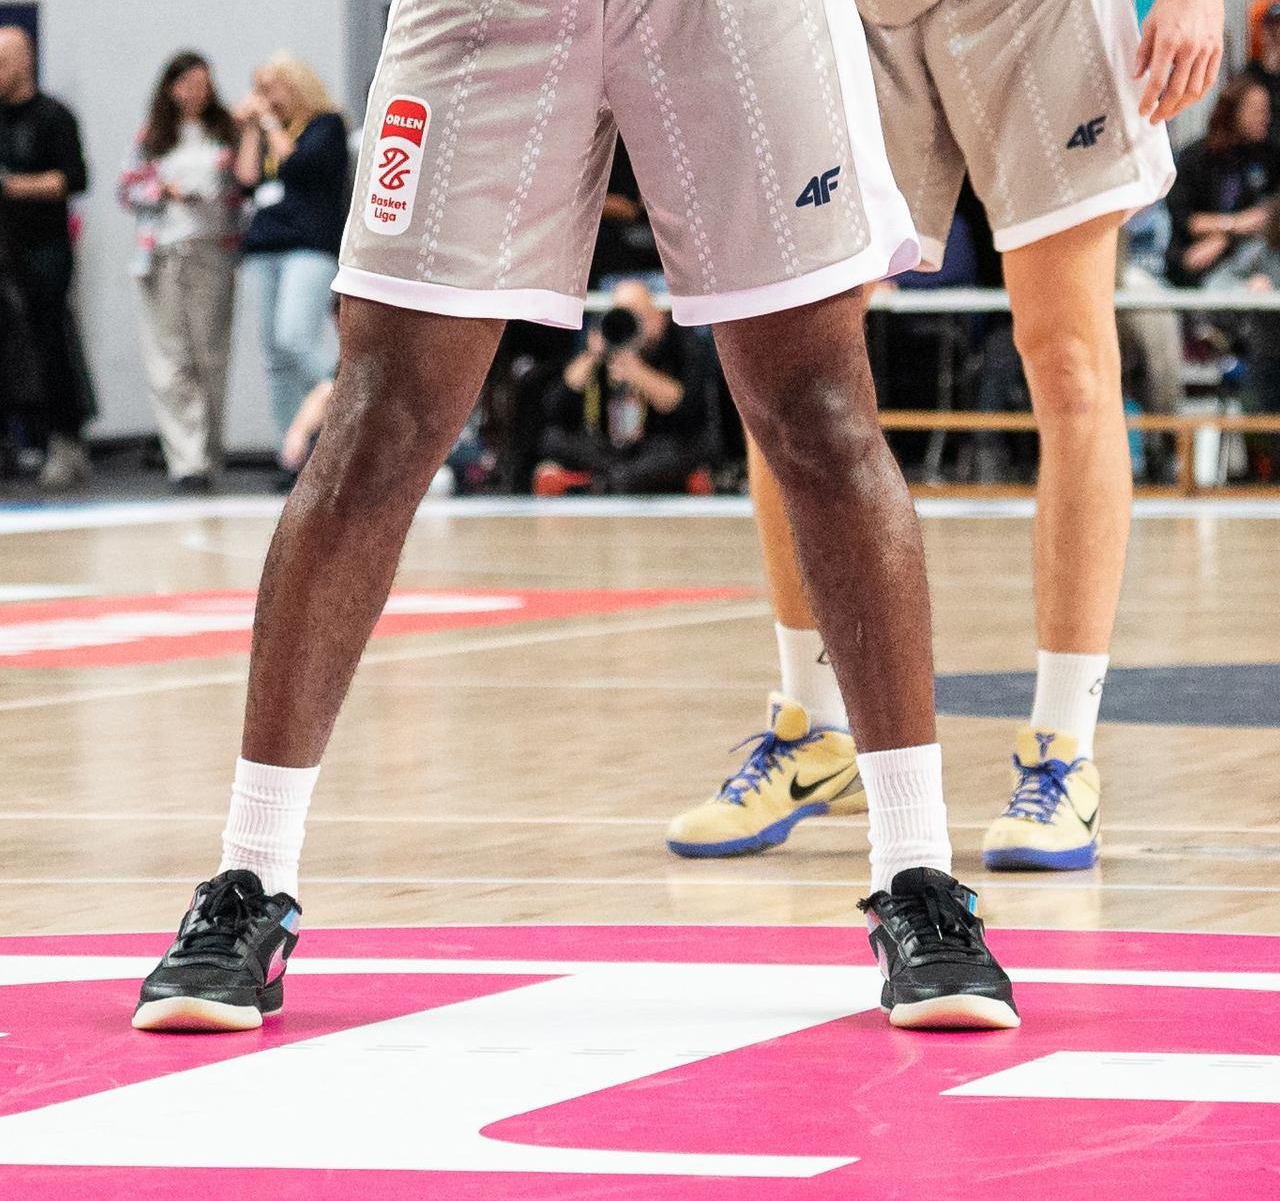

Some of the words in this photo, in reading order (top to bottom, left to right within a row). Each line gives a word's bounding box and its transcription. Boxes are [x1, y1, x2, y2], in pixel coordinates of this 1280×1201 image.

[385, 113, 424, 130] ORLEN
[371, 193, 408, 211] Basket
[374, 208, 397, 223] Liga
